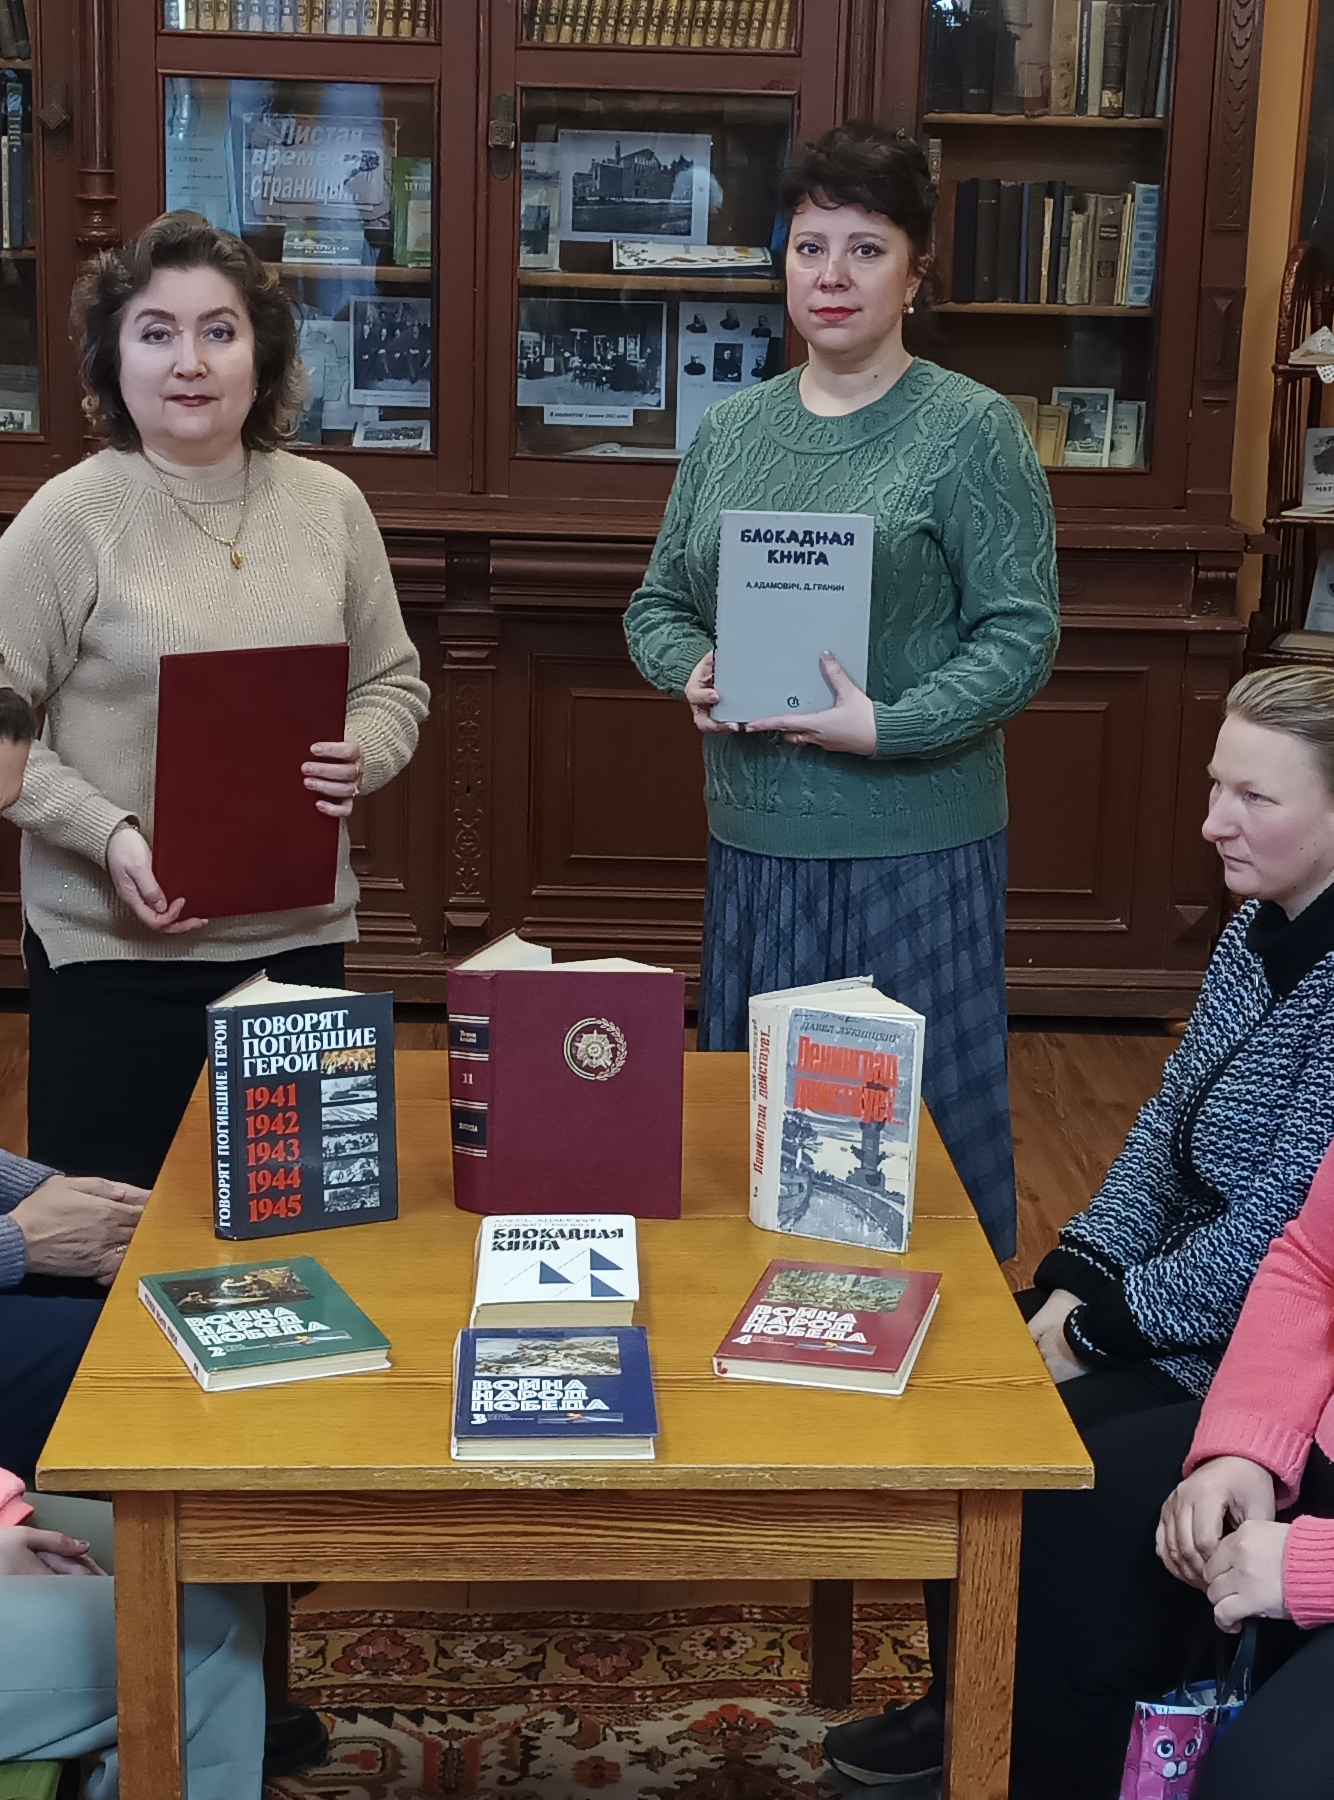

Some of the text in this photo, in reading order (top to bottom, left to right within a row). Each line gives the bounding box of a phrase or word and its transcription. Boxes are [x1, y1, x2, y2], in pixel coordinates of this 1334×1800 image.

[740, 527, 855, 548] БЛОКАДНАЯ
[767, 550, 829, 566] КНИГА
[241, 1009, 349, 1039] ГОВОРЯТ
[242, 1027, 377, 1058] ПОГИБШИЕ
[243, 1052, 318, 1078] ГЕРОИ
[795, 1035, 899, 1088] Ленинград
[462, 1072, 473, 1085] 11
[245, 1083, 298, 1111] 1941
[214, 1019, 231, 1228] ГОВОРЯТ ПОГИБШИЕ ГЕРОИ
[246, 1112, 300, 1139] 1942
[753, 1104, 767, 1175] Ленинград
[247, 1139, 300, 1166] 1943
[247, 1166, 301, 1194] 1944
[753, 1186, 758, 1198] 2
[248, 1194, 302, 1223] 1945
[493, 1228, 624, 1240] БЛОКАДНАЯ
[491, 1240, 560, 1251] КНИГА
[184, 1306, 297, 1328] ВОЙНА
[746, 1313, 855, 1332] НАРОД
[752, 1304, 857, 1324] ВОЙНА
[193, 1315, 304, 1336] НАРОД
[197, 1321, 332, 1346] ПОБЕДА
[740, 1323, 867, 1344] ПОБЕДА
[731, 1334, 753, 1345] 4
[207, 1346, 226, 1358] 2
[472, 1378, 588, 1390] ВОЙНА
[470, 1399, 610, 1412] ПОБЕДА
[471, 1390, 589, 1401] НАРОД
[470, 1413, 487, 1425] 3
